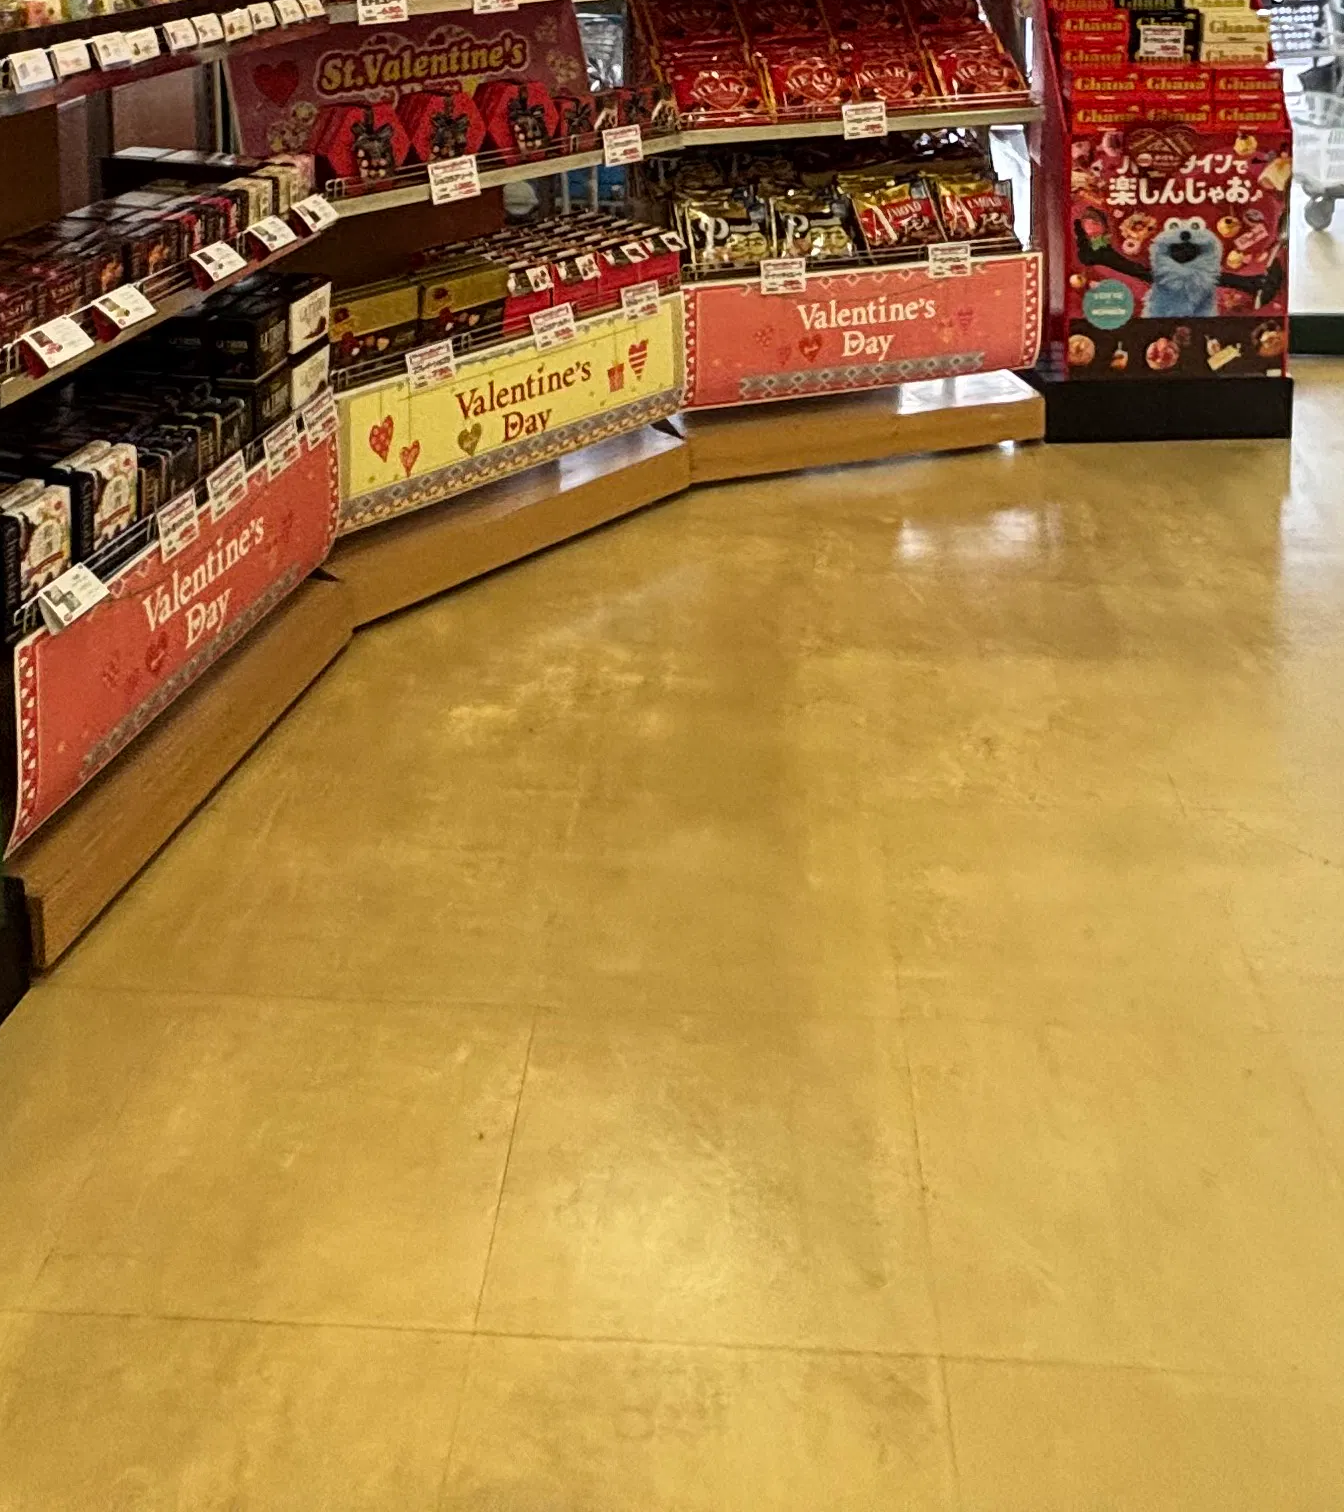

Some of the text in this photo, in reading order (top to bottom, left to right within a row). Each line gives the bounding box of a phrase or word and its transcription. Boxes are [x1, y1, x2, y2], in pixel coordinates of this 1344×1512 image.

[1064, 18, 1124, 33] Ghana
[1074, 77, 1136, 91] Ghana
[1145, 76, 1207, 91] Ghana
[1218, 76, 1280, 92] Ghana
[1218, 107, 1279, 123] Ghana
[798, 298, 937, 330] Valentine's
[842, 332, 895, 359] Day
[455, 360, 593, 419] Valentine's
[501, 407, 554, 443] Day
[140, 512, 266, 632] Valentine's
[183, 587, 232, 650] Day
